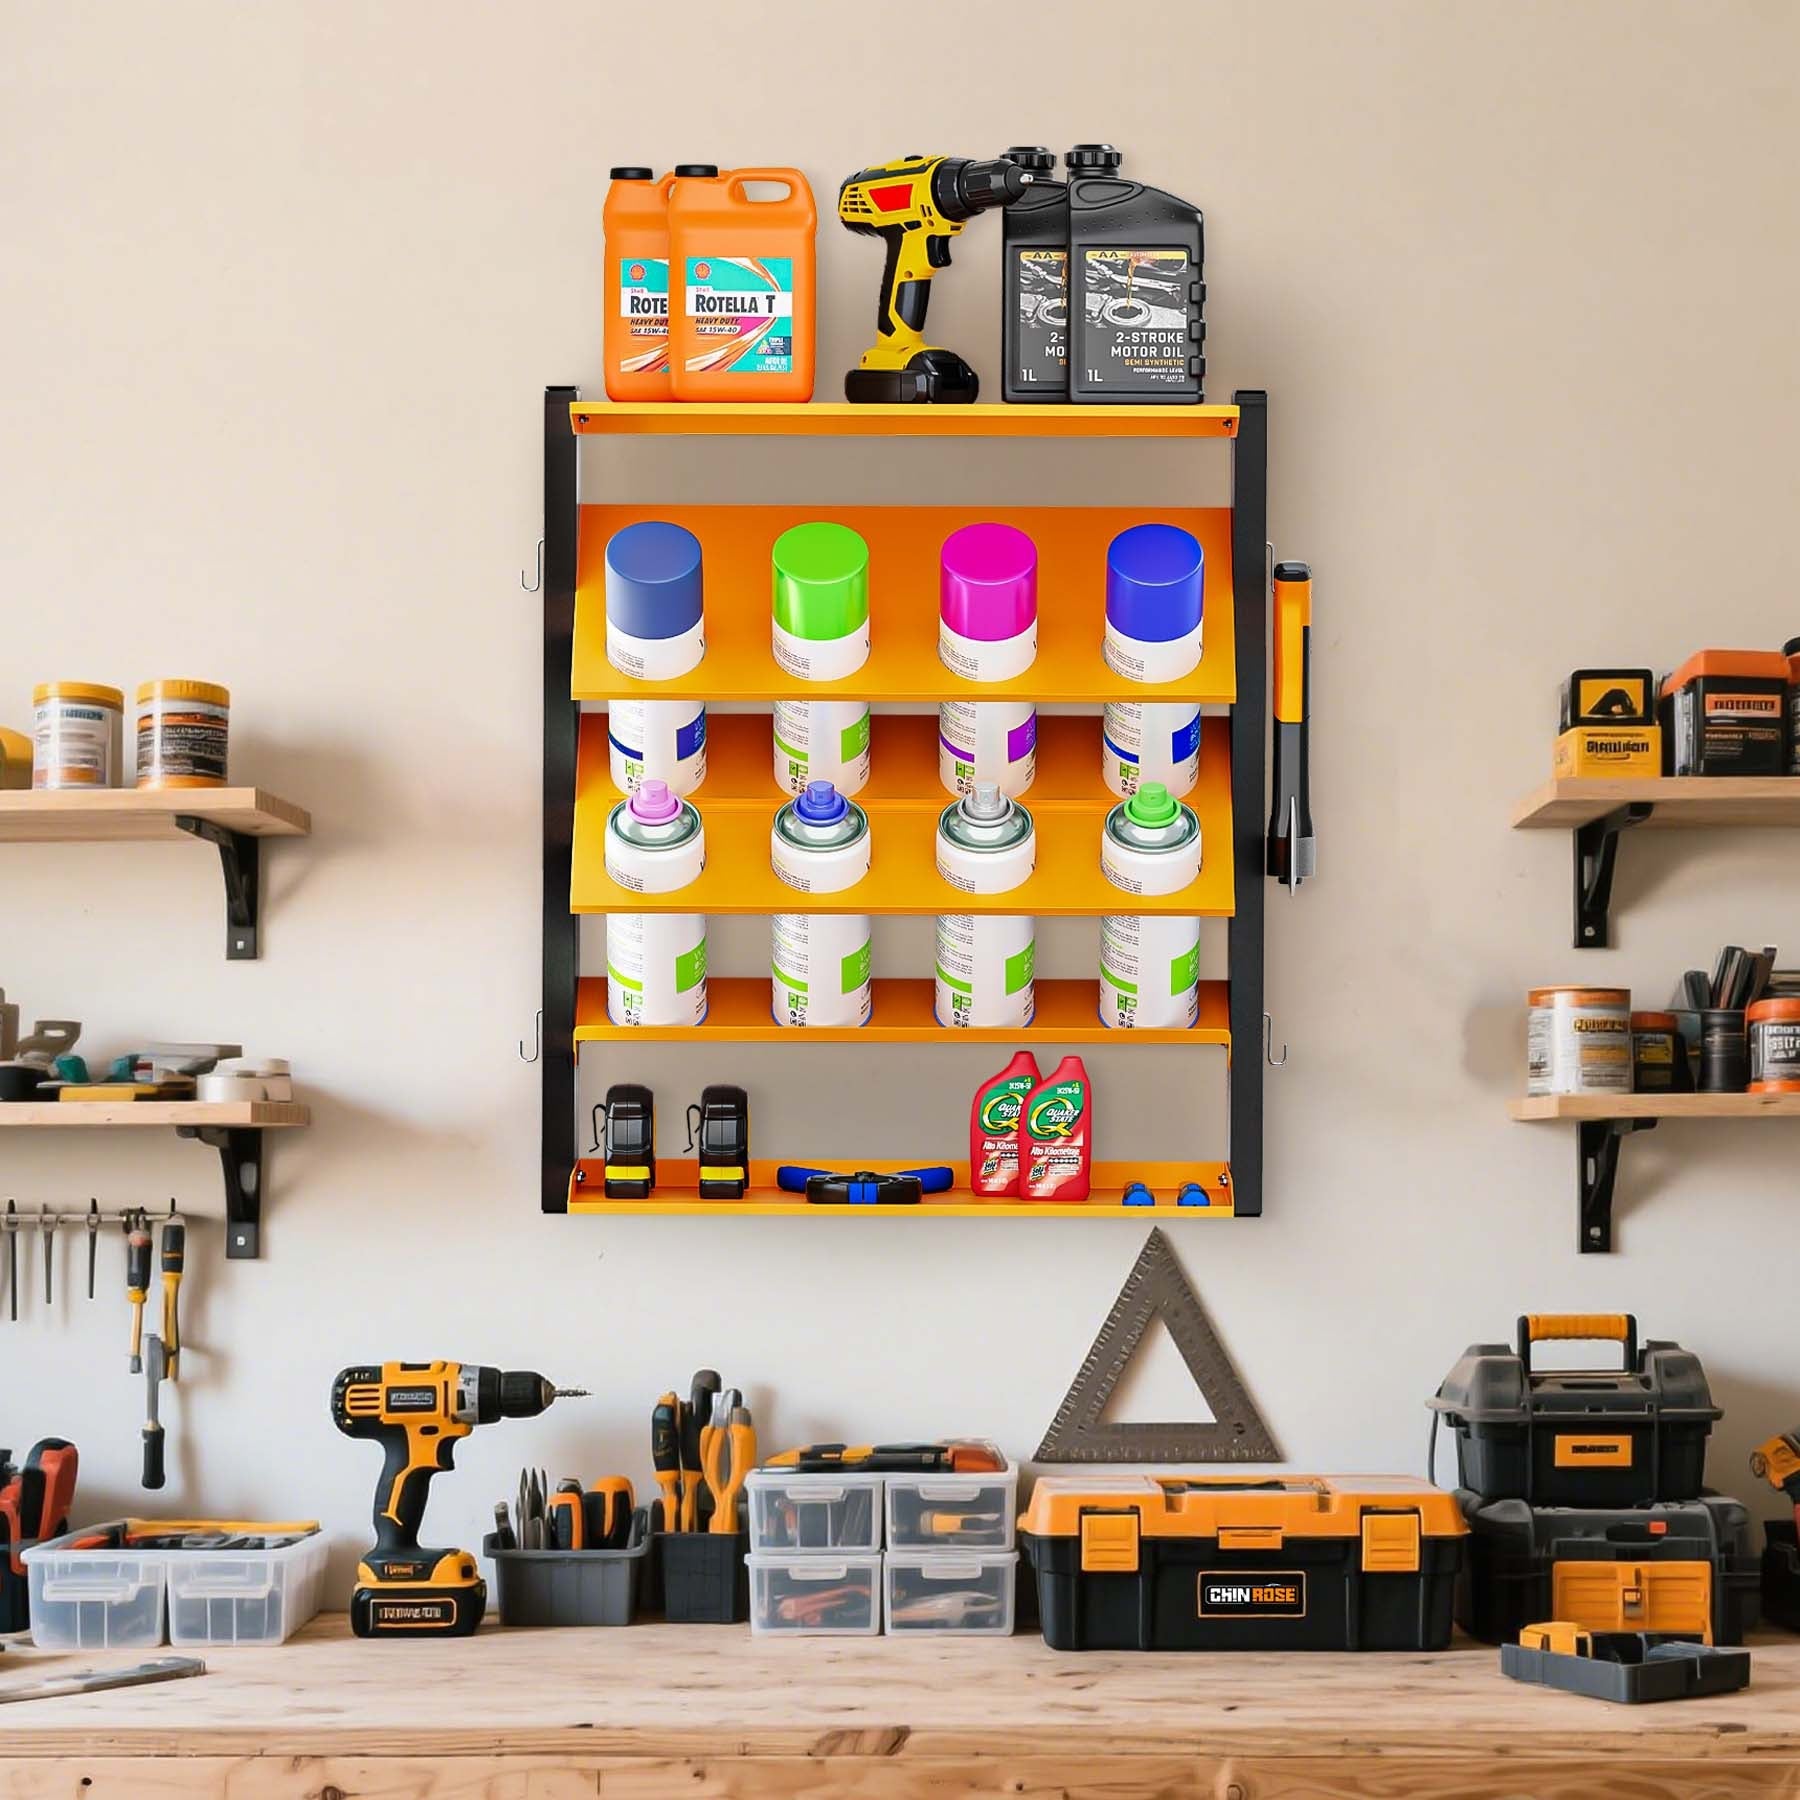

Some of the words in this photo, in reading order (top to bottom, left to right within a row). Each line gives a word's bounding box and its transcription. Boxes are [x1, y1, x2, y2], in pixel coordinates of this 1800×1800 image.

[630, 295, 668, 314] ROTE
[695, 294, 759, 313] ROTELLA
[765, 295, 776, 314] T
[630, 318, 654, 326] HEAVY
[695, 317, 719, 325] HEAVY
[720, 317, 740, 325] DUTY
[1116, 332, 1184, 343] 2-STROKE
[1045, 346, 1065, 357] MO
[1111, 346, 1158, 358] MOTOR
[1163, 346, 1185, 358] OIL
[1022, 369, 1037, 382] 1L
[1087, 369, 1104, 382] 1L
[1046, 1108, 1080, 1117] QUAKER
[1049, 1115, 1074, 1123] STATE
[983, 1141, 996, 1150] Alto
[1030, 1147, 1043, 1155] Alto
[1252, 1587, 1296, 1602] ROSE
